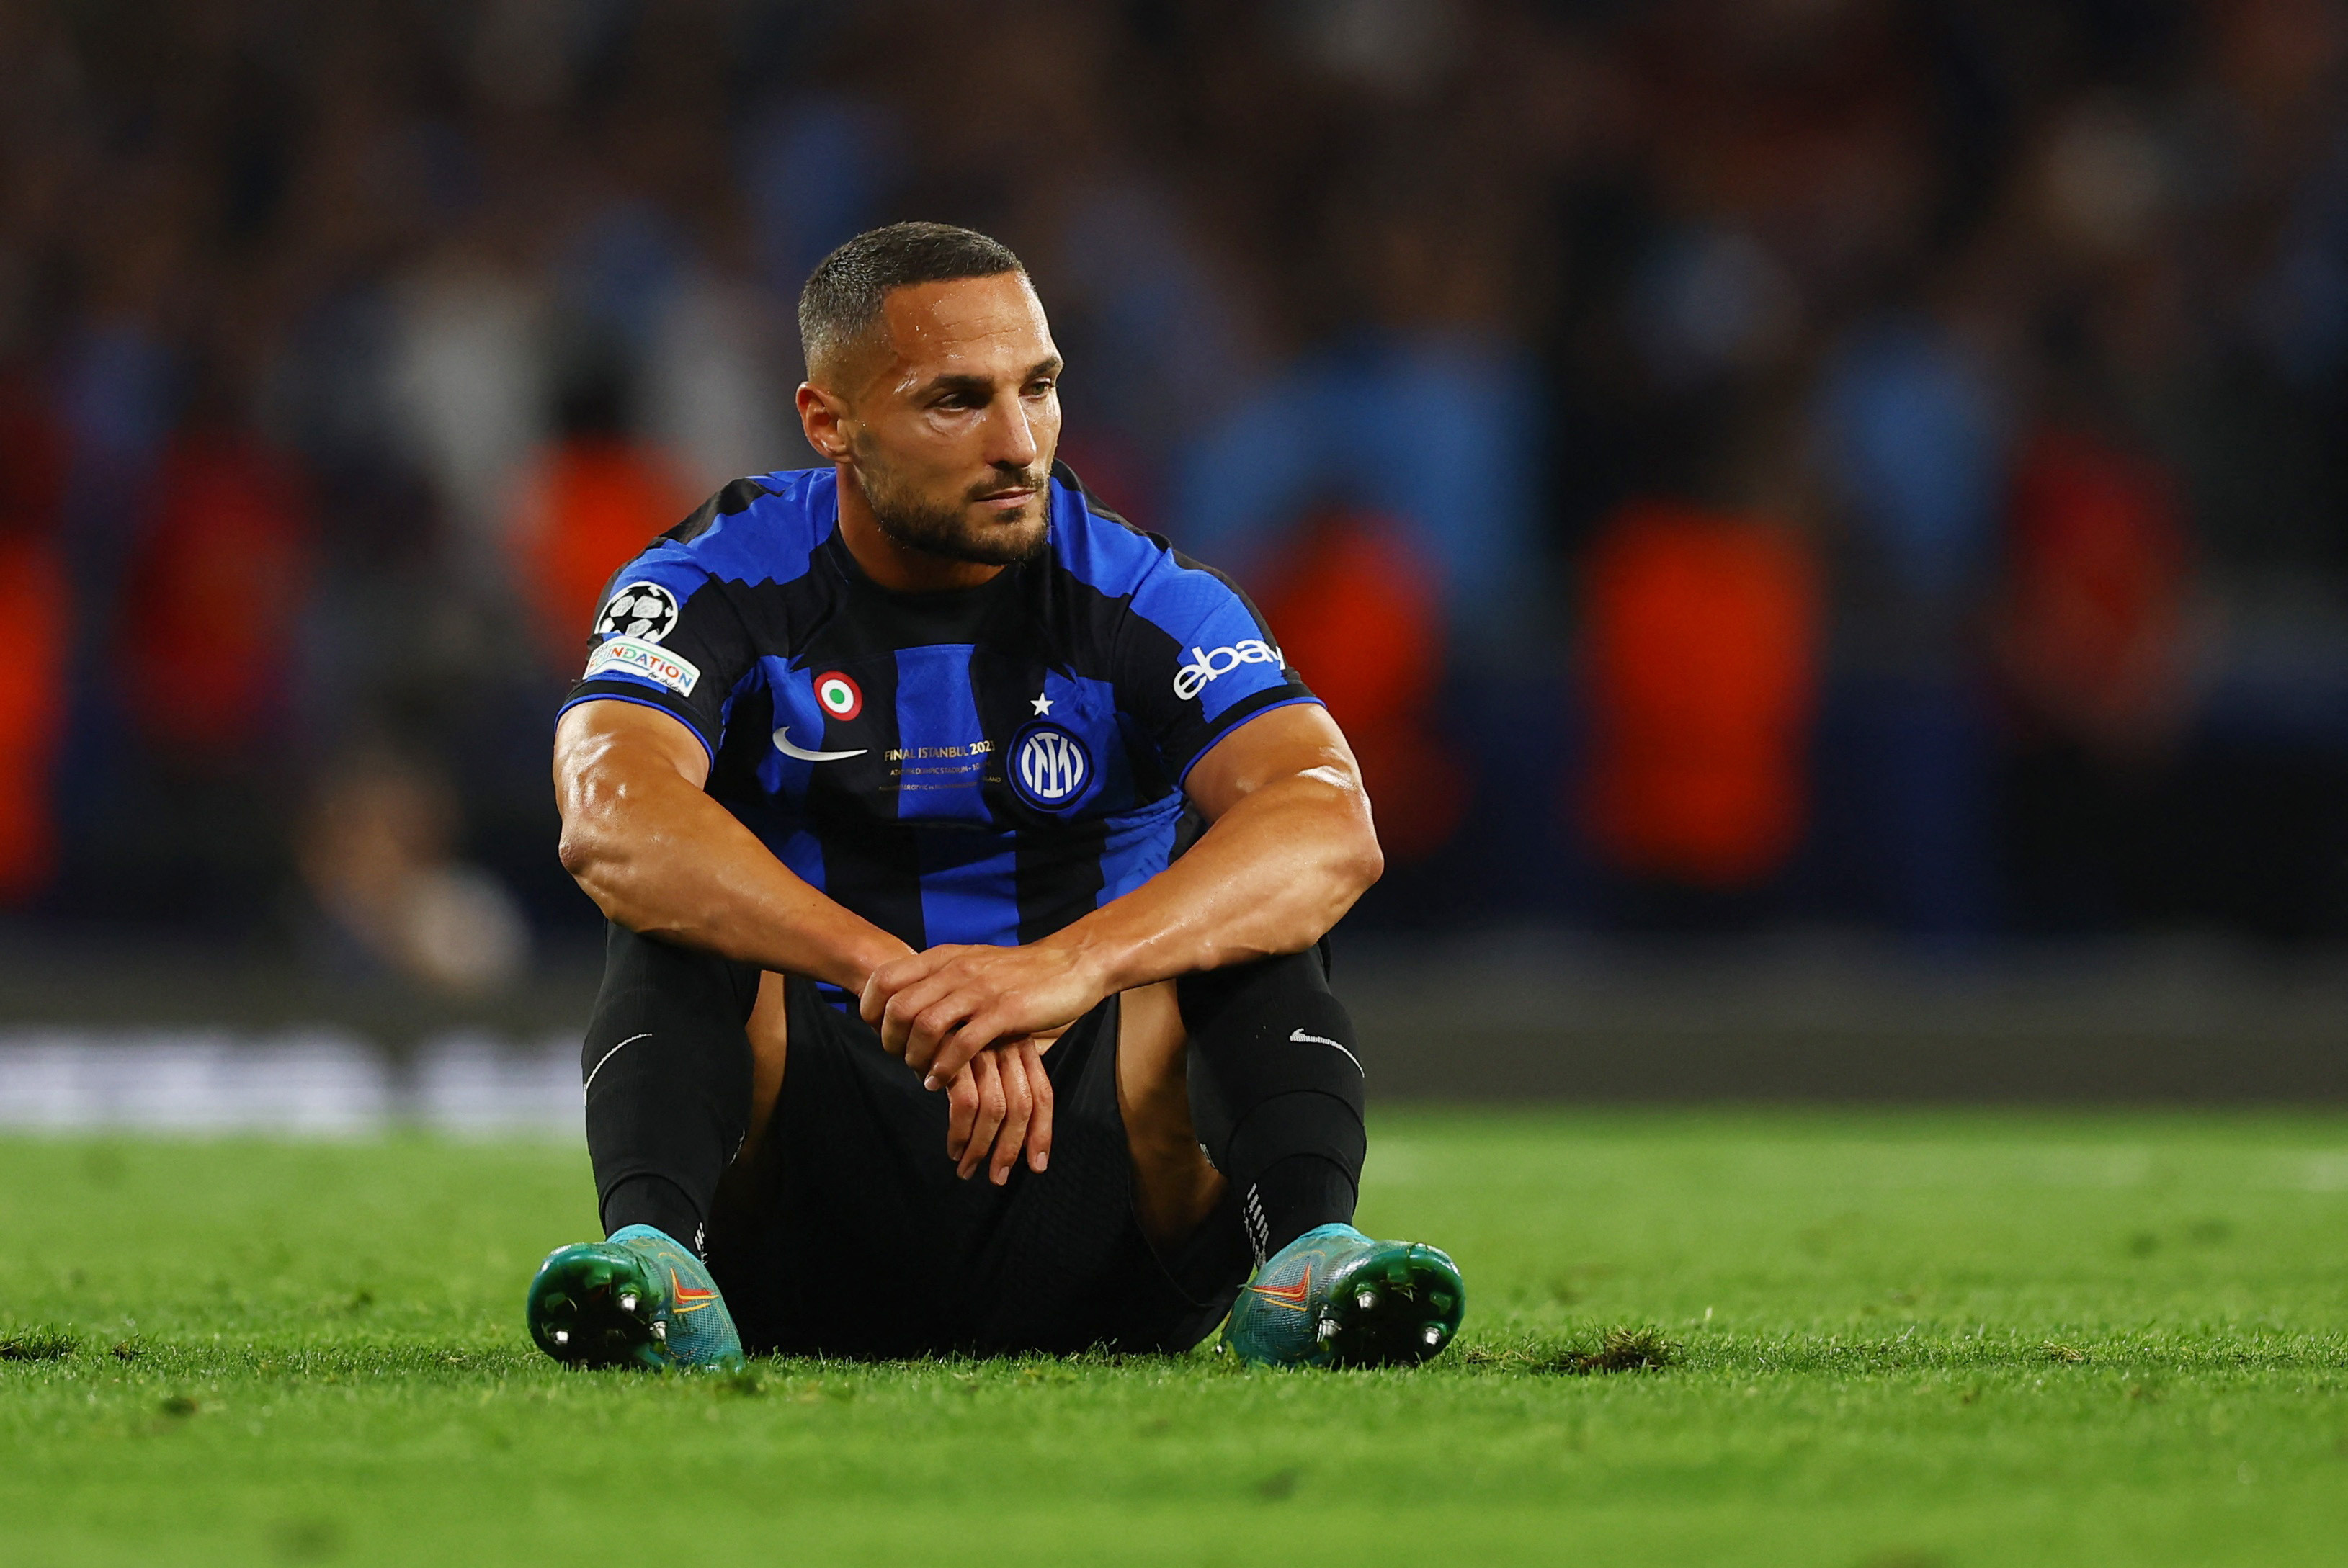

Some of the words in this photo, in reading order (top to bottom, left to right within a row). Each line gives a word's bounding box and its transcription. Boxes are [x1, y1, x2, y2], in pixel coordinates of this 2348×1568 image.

[1173, 639, 1286, 701] ebay
[885, 748, 916, 761] FINAL
[918, 746, 969, 759] ISTANBUL
